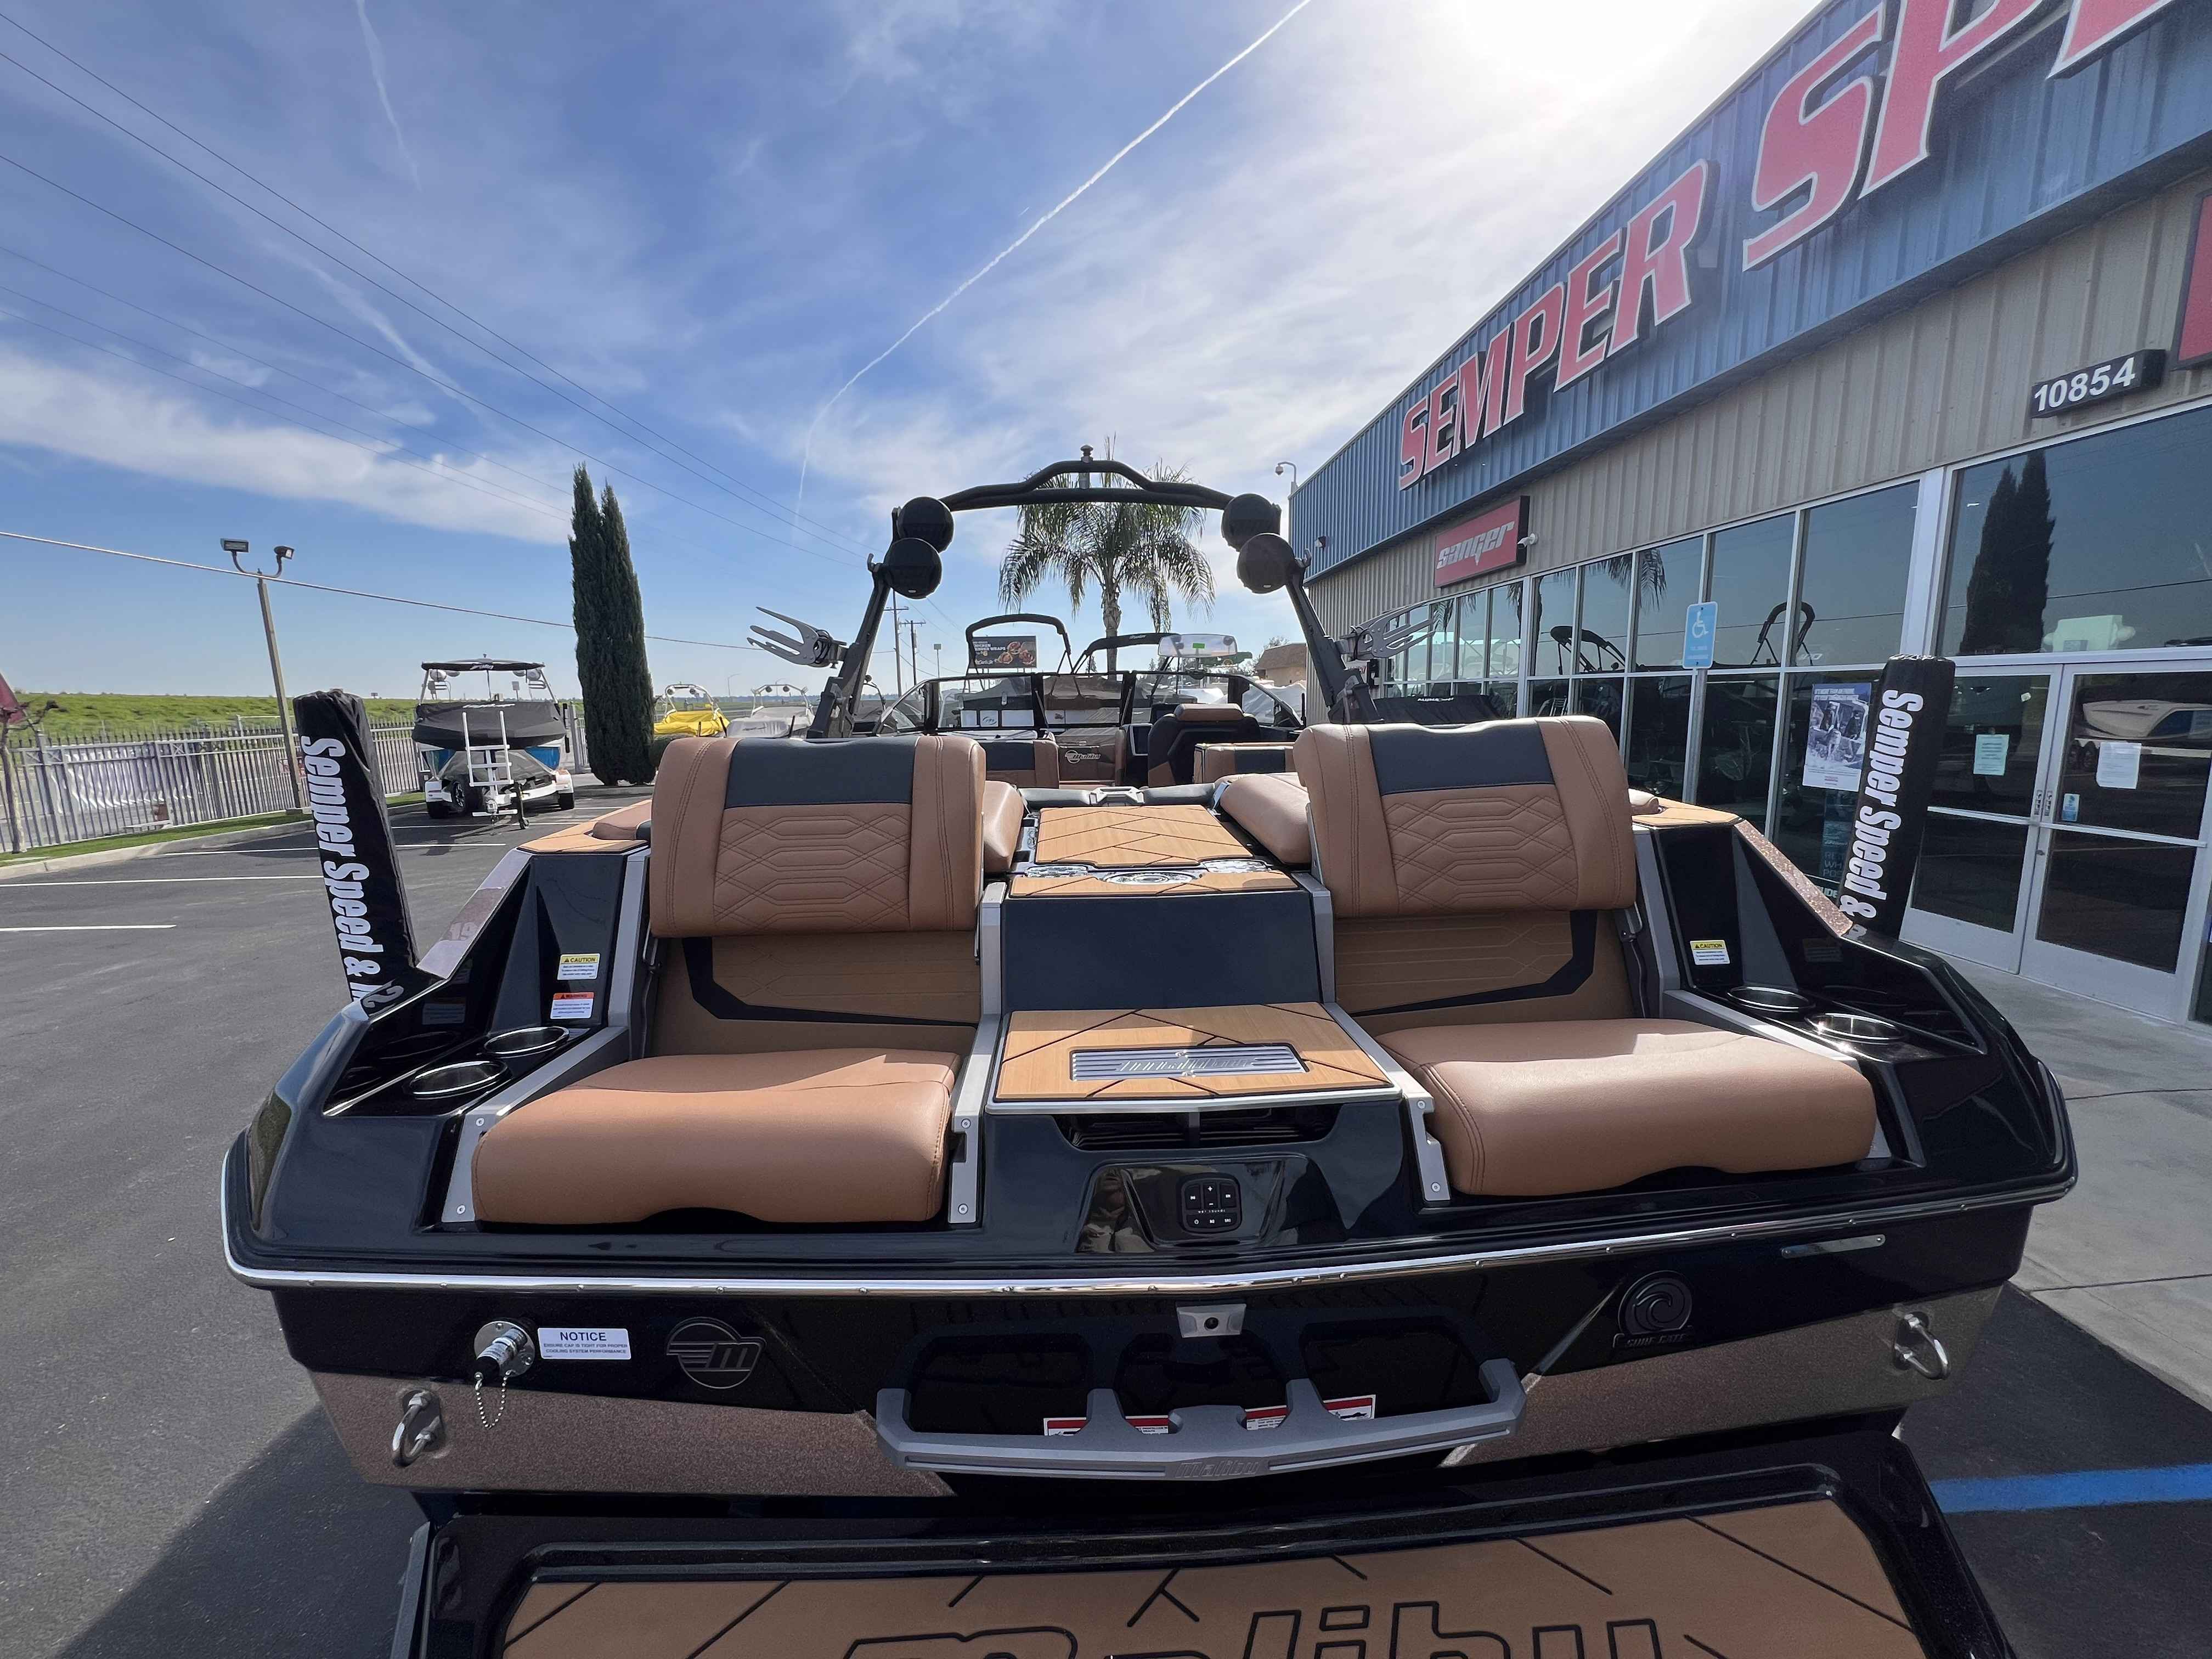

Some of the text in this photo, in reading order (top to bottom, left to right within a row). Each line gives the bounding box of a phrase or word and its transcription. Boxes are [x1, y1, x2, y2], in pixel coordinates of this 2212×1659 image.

[1400, 0, 2170, 490] SEMPER SP
[2034, 357, 2135, 411] 10854
[301, 736, 357, 857] Semper
[1839, 689, 1924, 919] Semper Speed &
[323, 862, 383, 953] Speed
[344, 957, 381, 977] &
[560, 1331, 607, 1341] NOTICE
